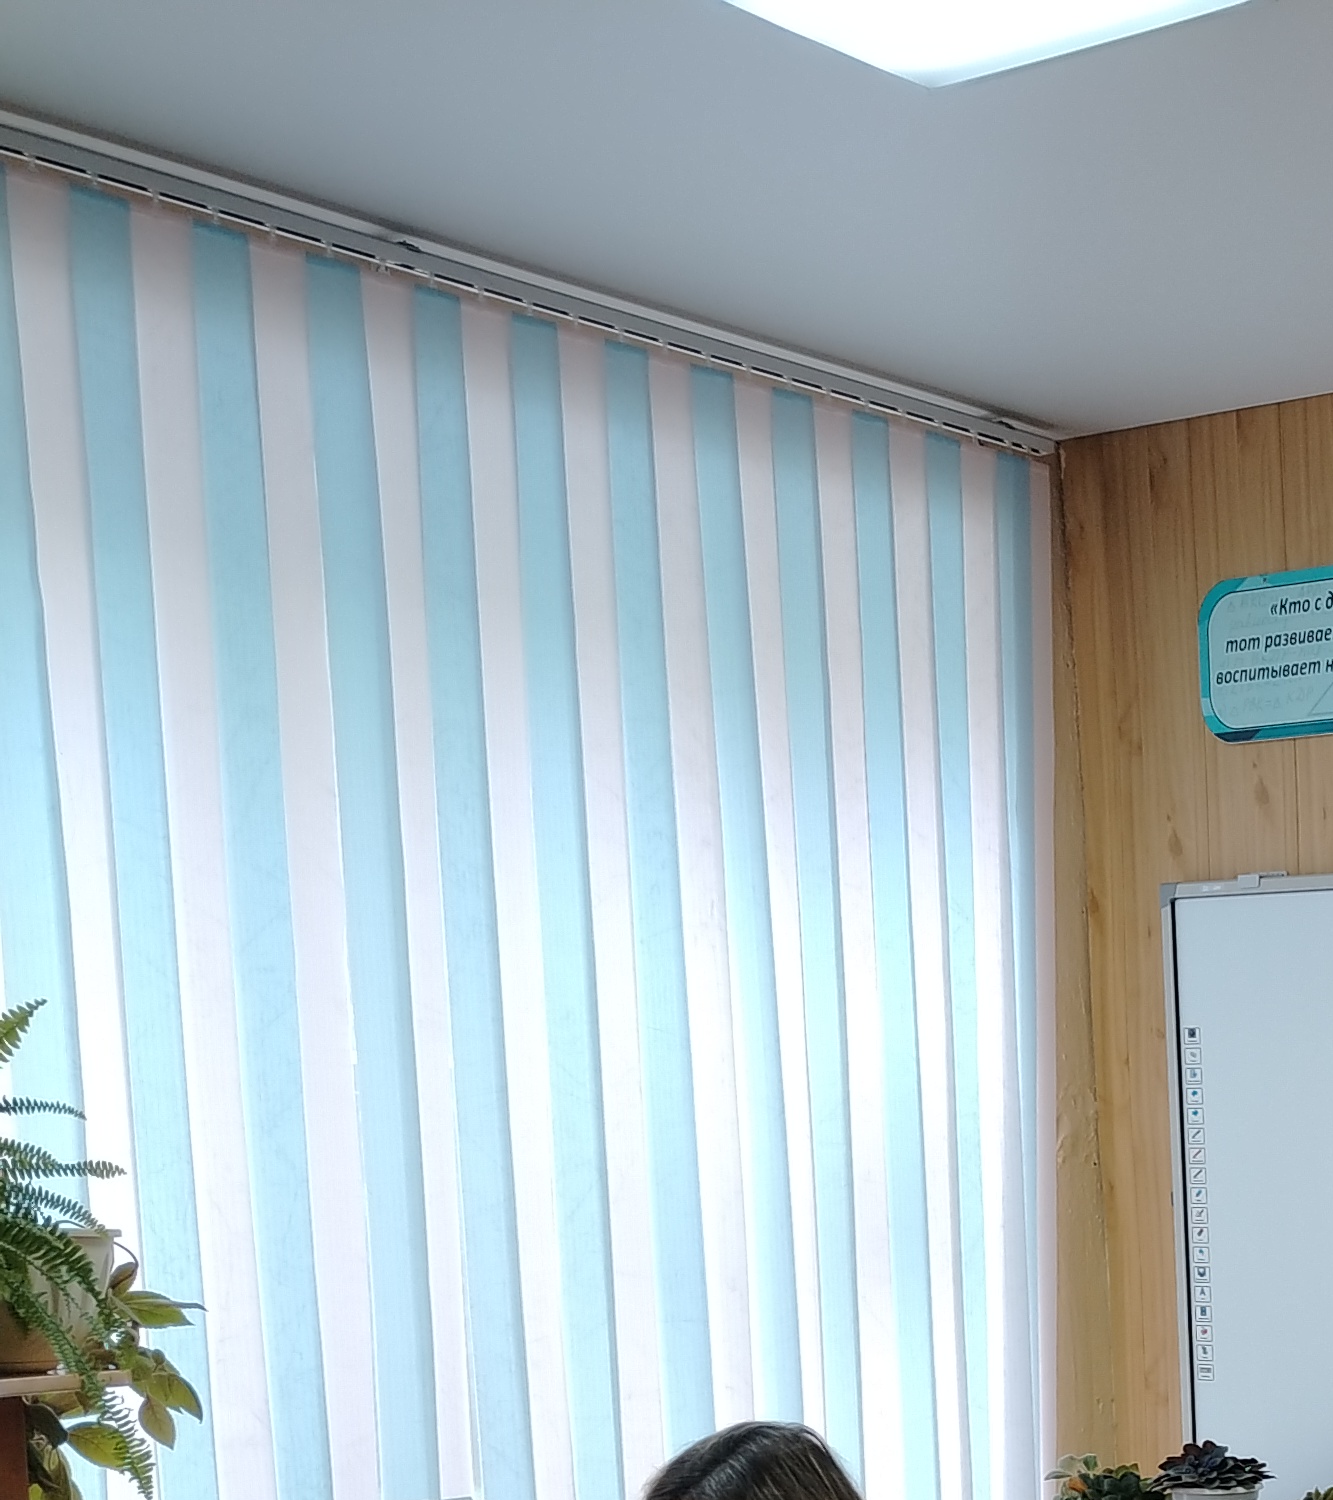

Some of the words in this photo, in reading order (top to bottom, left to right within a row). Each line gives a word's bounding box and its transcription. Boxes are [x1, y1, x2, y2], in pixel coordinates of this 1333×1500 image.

[1314, 597, 1322, 611] с
[1225, 636, 1261, 654] тот
[1216, 660, 1321, 685] воспитывает
